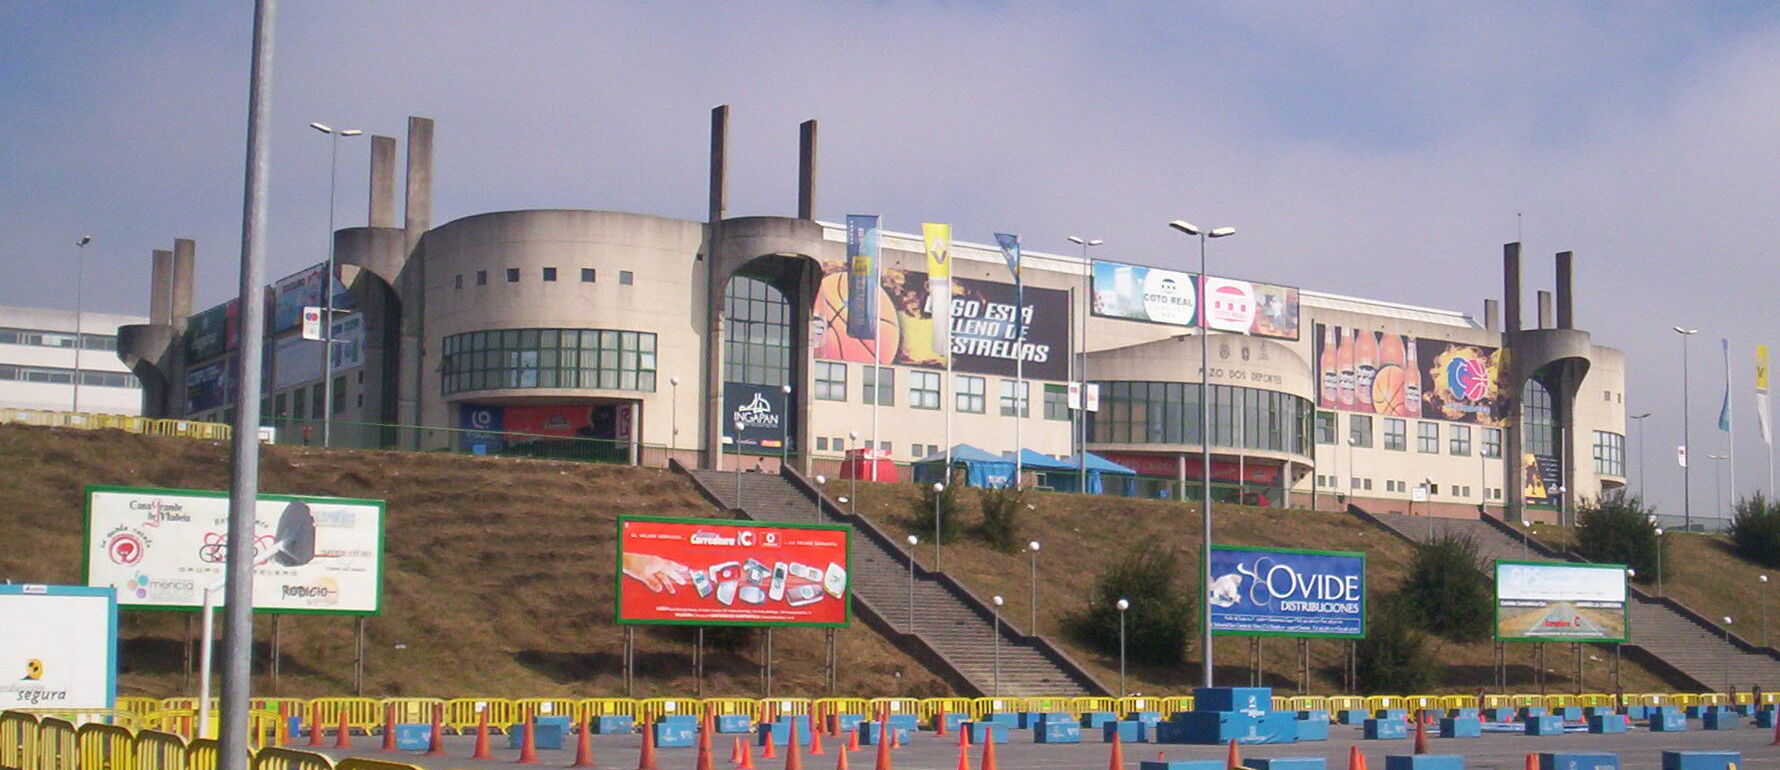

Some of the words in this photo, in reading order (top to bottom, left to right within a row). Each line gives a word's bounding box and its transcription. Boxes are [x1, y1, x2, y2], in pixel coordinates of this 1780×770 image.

[924, 295, 980, 318] LGO
[1144, 293, 1168, 304] COTO
[1170, 297, 1193, 307] REAL
[1198, 368, 1224, 378] PZO
[1229, 370, 1246, 380] DOS
[733, 411, 779, 425] INGAPAN
[1267, 564, 1360, 601] OVIDE
[282, 585, 328, 600] RODICIO
[1280, 600, 1360, 614] DISTRIBUCIONES
[16, 689, 66, 705] segura
